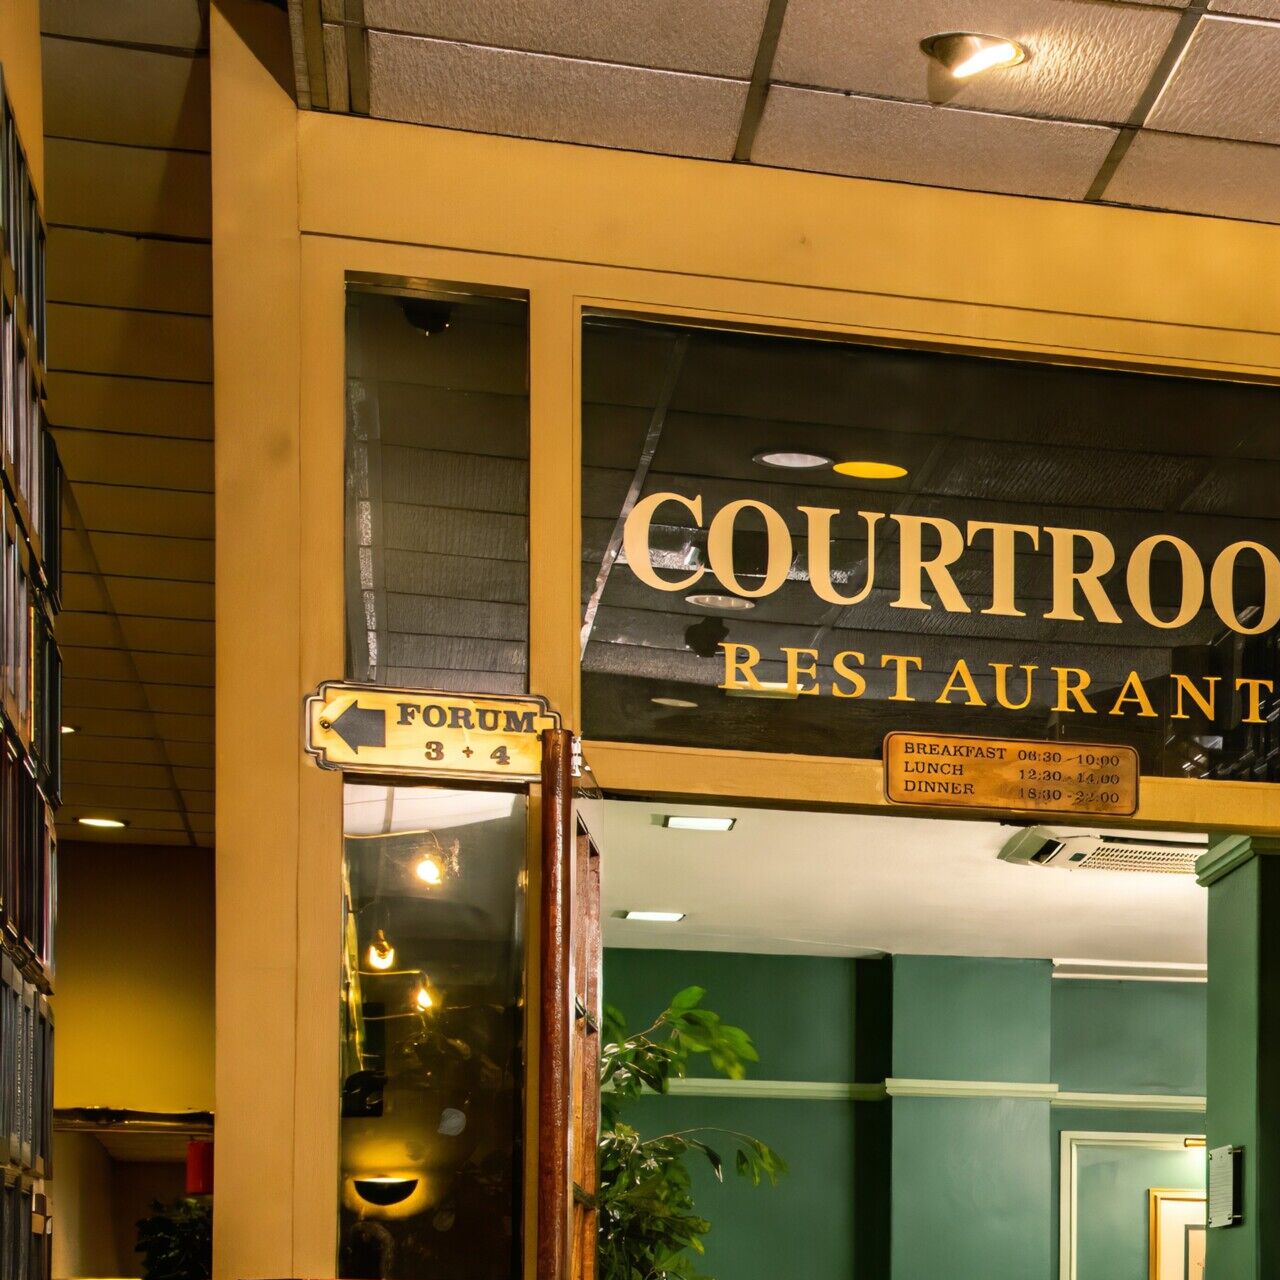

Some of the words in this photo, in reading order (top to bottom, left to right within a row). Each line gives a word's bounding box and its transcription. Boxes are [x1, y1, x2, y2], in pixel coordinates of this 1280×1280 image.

[718, 642, 1274, 723] RESTAURANT
[397, 703, 538, 733] FORUM
[425, 741, 444, 761] 3
[490, 746, 510, 765] 4
[904, 742, 1006, 759] BREAKFAST
[904, 761, 964, 775] LUNCH
[904, 780, 975, 794] DINNER
